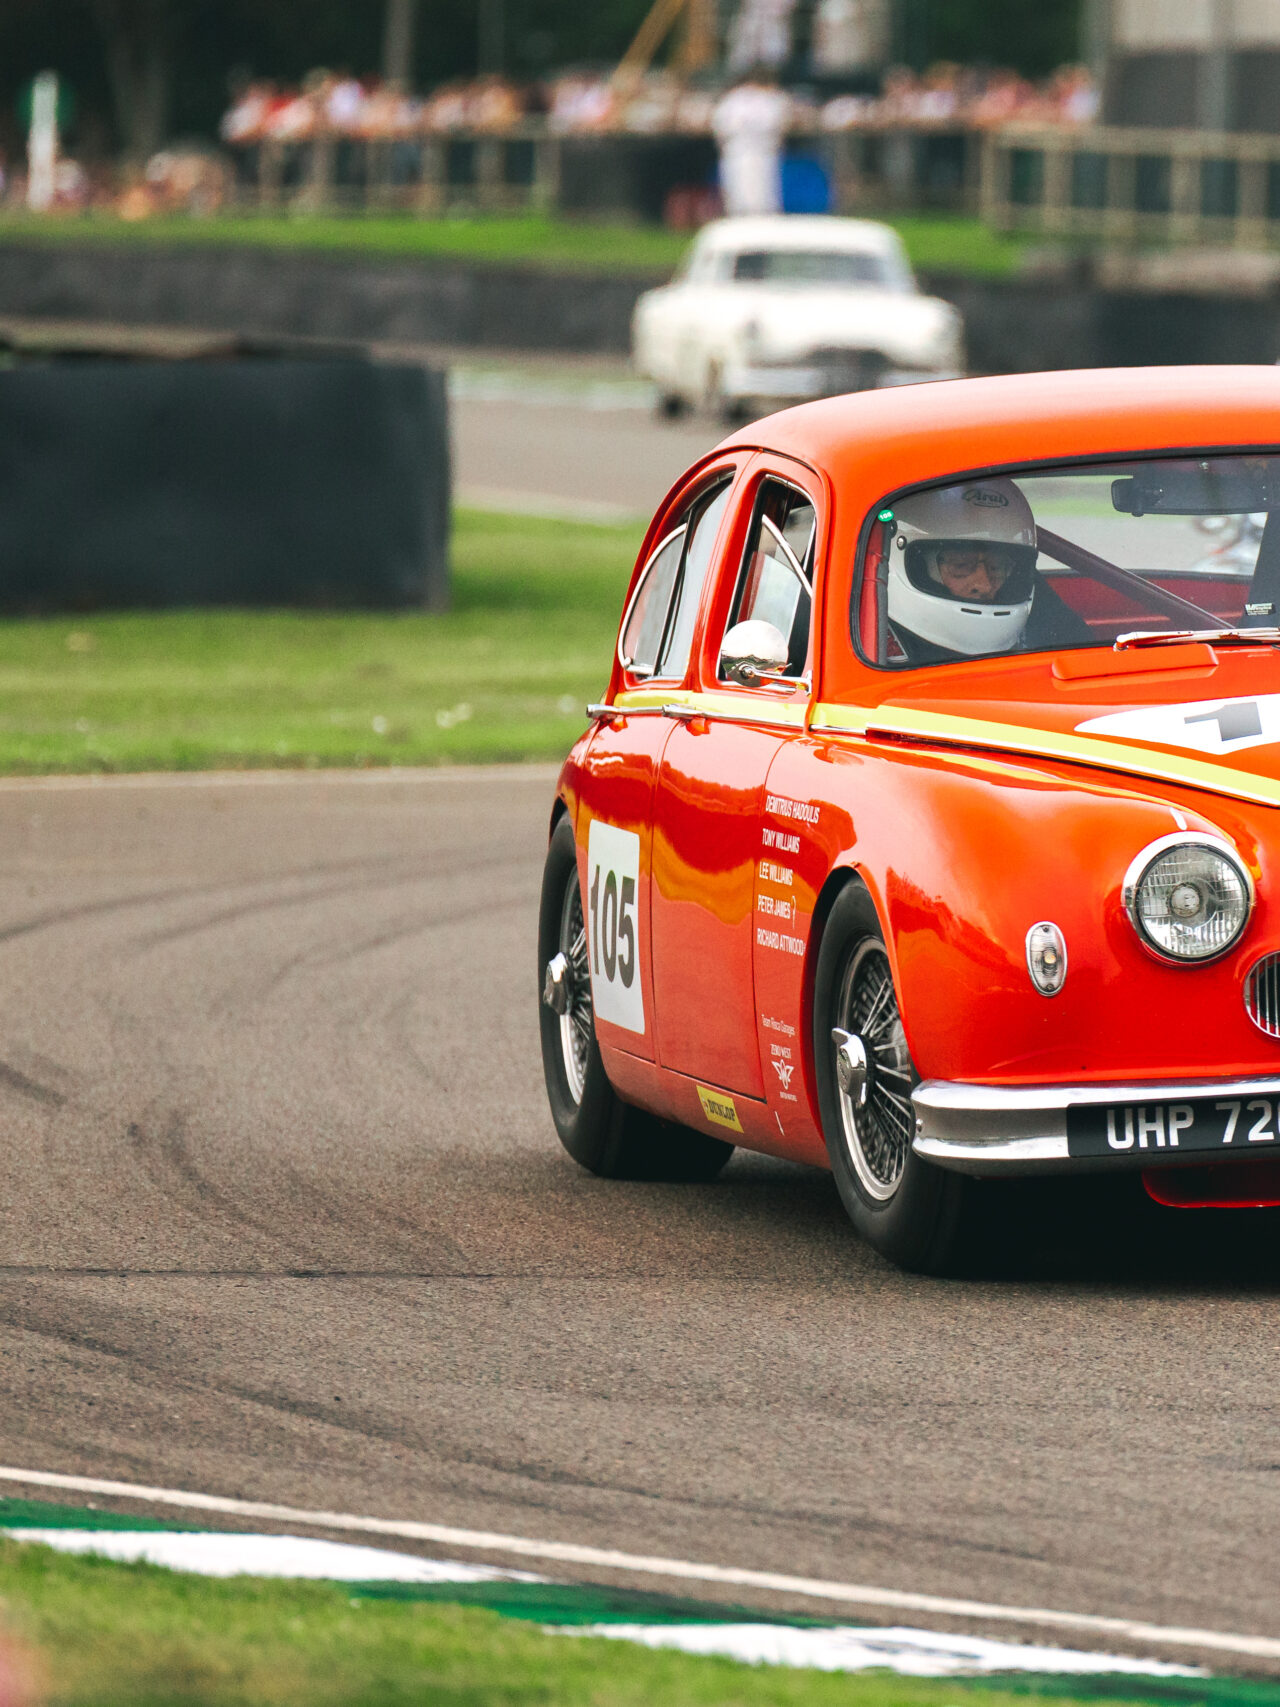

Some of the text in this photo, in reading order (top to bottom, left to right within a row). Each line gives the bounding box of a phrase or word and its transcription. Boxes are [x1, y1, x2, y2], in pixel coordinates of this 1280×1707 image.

[762, 828, 800, 854] TONY WILLIAMS
[759, 861, 793, 886] LEE WILLIAMS
[757, 894, 791, 919] PETER JAMES
[590, 863, 636, 989] 105
[757, 928, 804, 956] RICHARD ATTWOOD
[707, 1099, 736, 1122] DUNLOP
[1107, 1104, 1194, 1150] UHP
